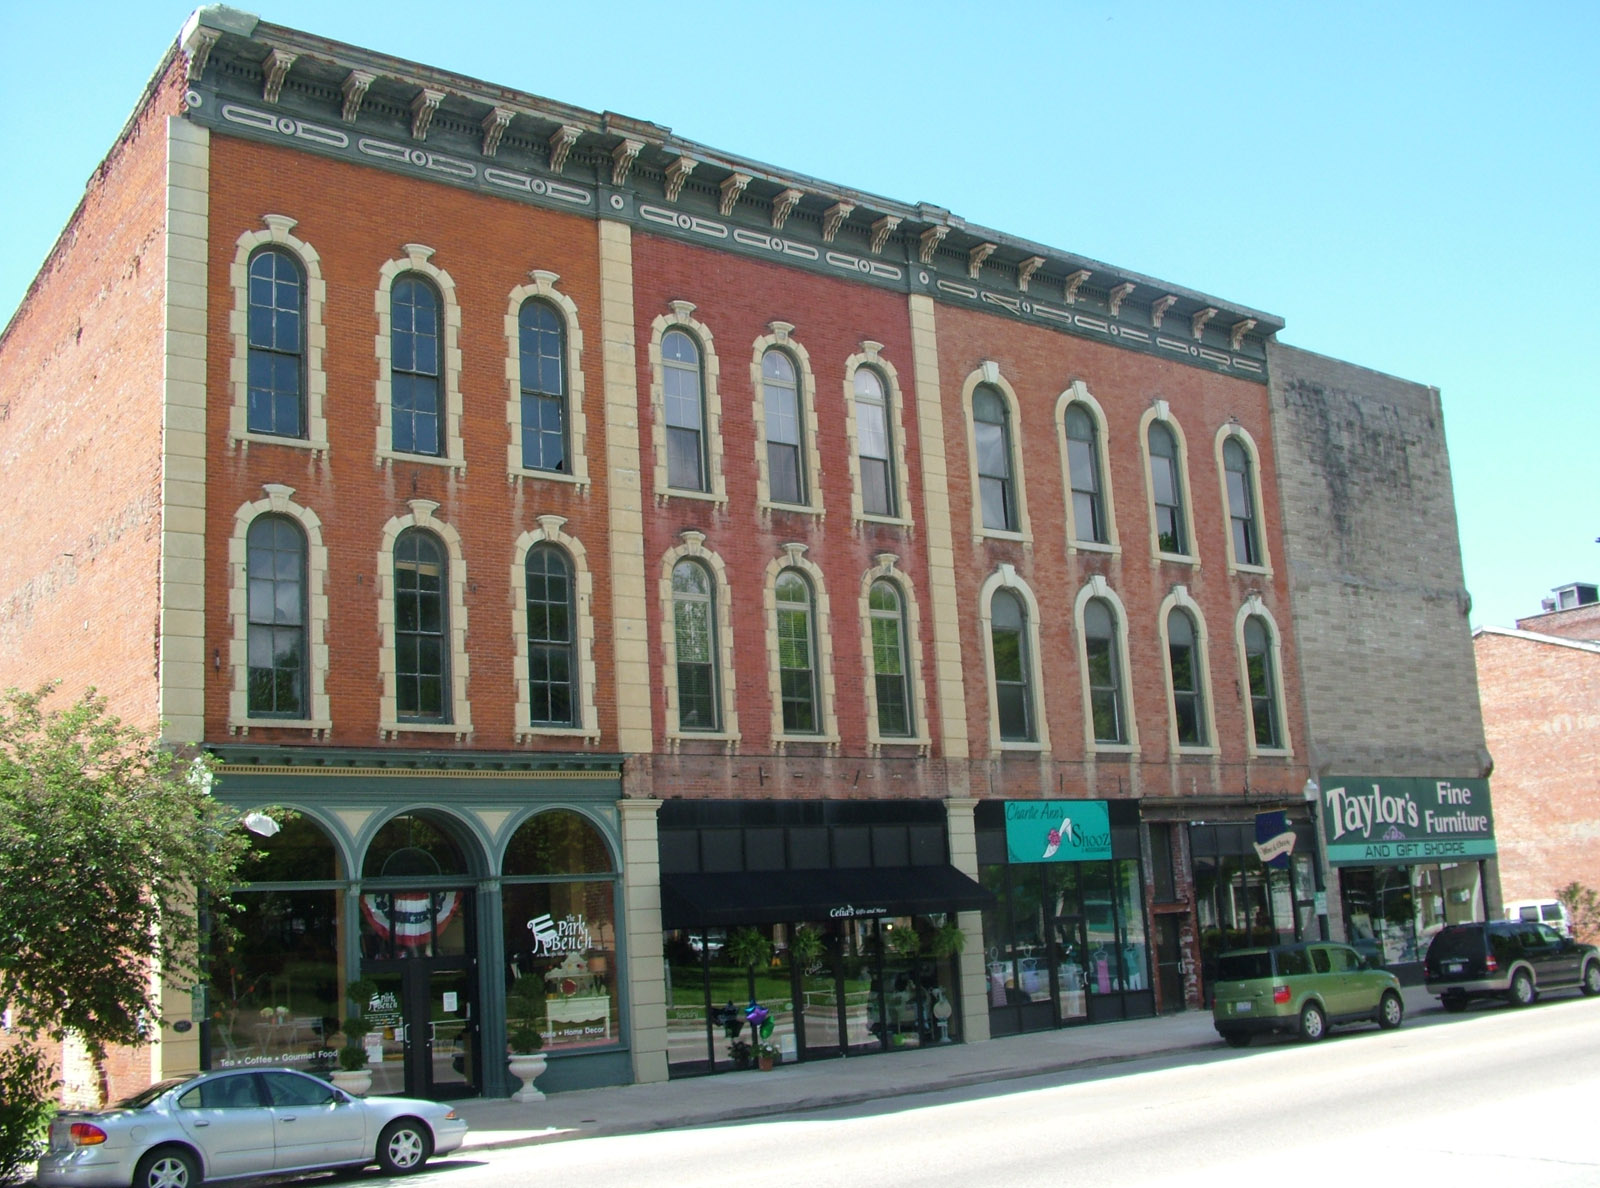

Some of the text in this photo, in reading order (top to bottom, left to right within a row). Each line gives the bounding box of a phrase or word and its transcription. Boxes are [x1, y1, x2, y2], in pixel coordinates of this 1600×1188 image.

[1436, 781, 1471, 805] Fine
[1007, 803, 1039, 820] Charlie
[1326, 784, 1419, 840] Taylor's
[1425, 810, 1488, 833] Furniture
[1072, 824, 1110, 848] Shooz
[1365, 842, 1466, 858] AND GIFT SHOPPE
[557, 914, 585, 936] Park
[552, 929, 592, 951] Bench
[221, 1050, 338, 1067] Tea Coffee Gourmet Food
